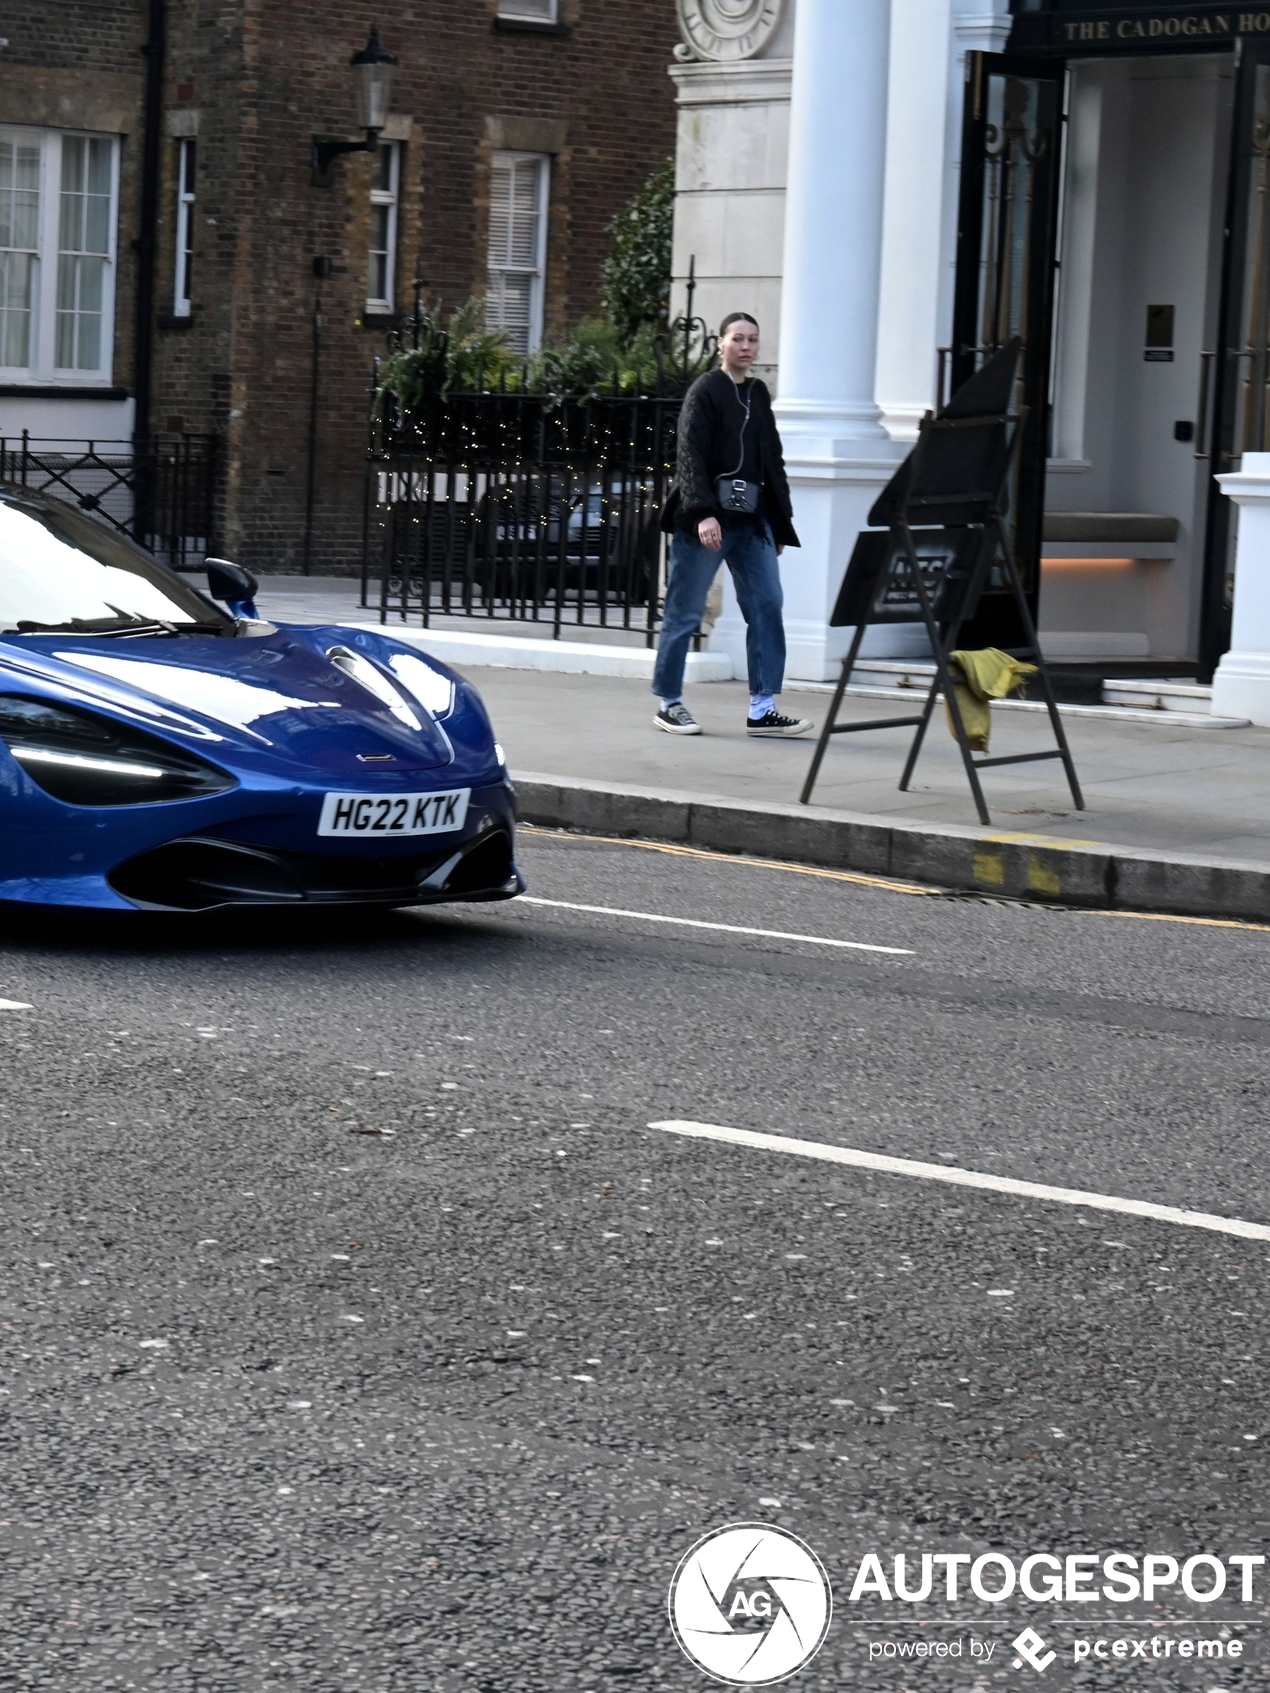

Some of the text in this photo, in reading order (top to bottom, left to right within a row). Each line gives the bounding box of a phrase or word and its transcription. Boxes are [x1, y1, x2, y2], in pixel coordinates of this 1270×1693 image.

[1064, 13, 1270, 40] THE CADOGAN HO
[332, 794, 462, 831] HG22 KTK
